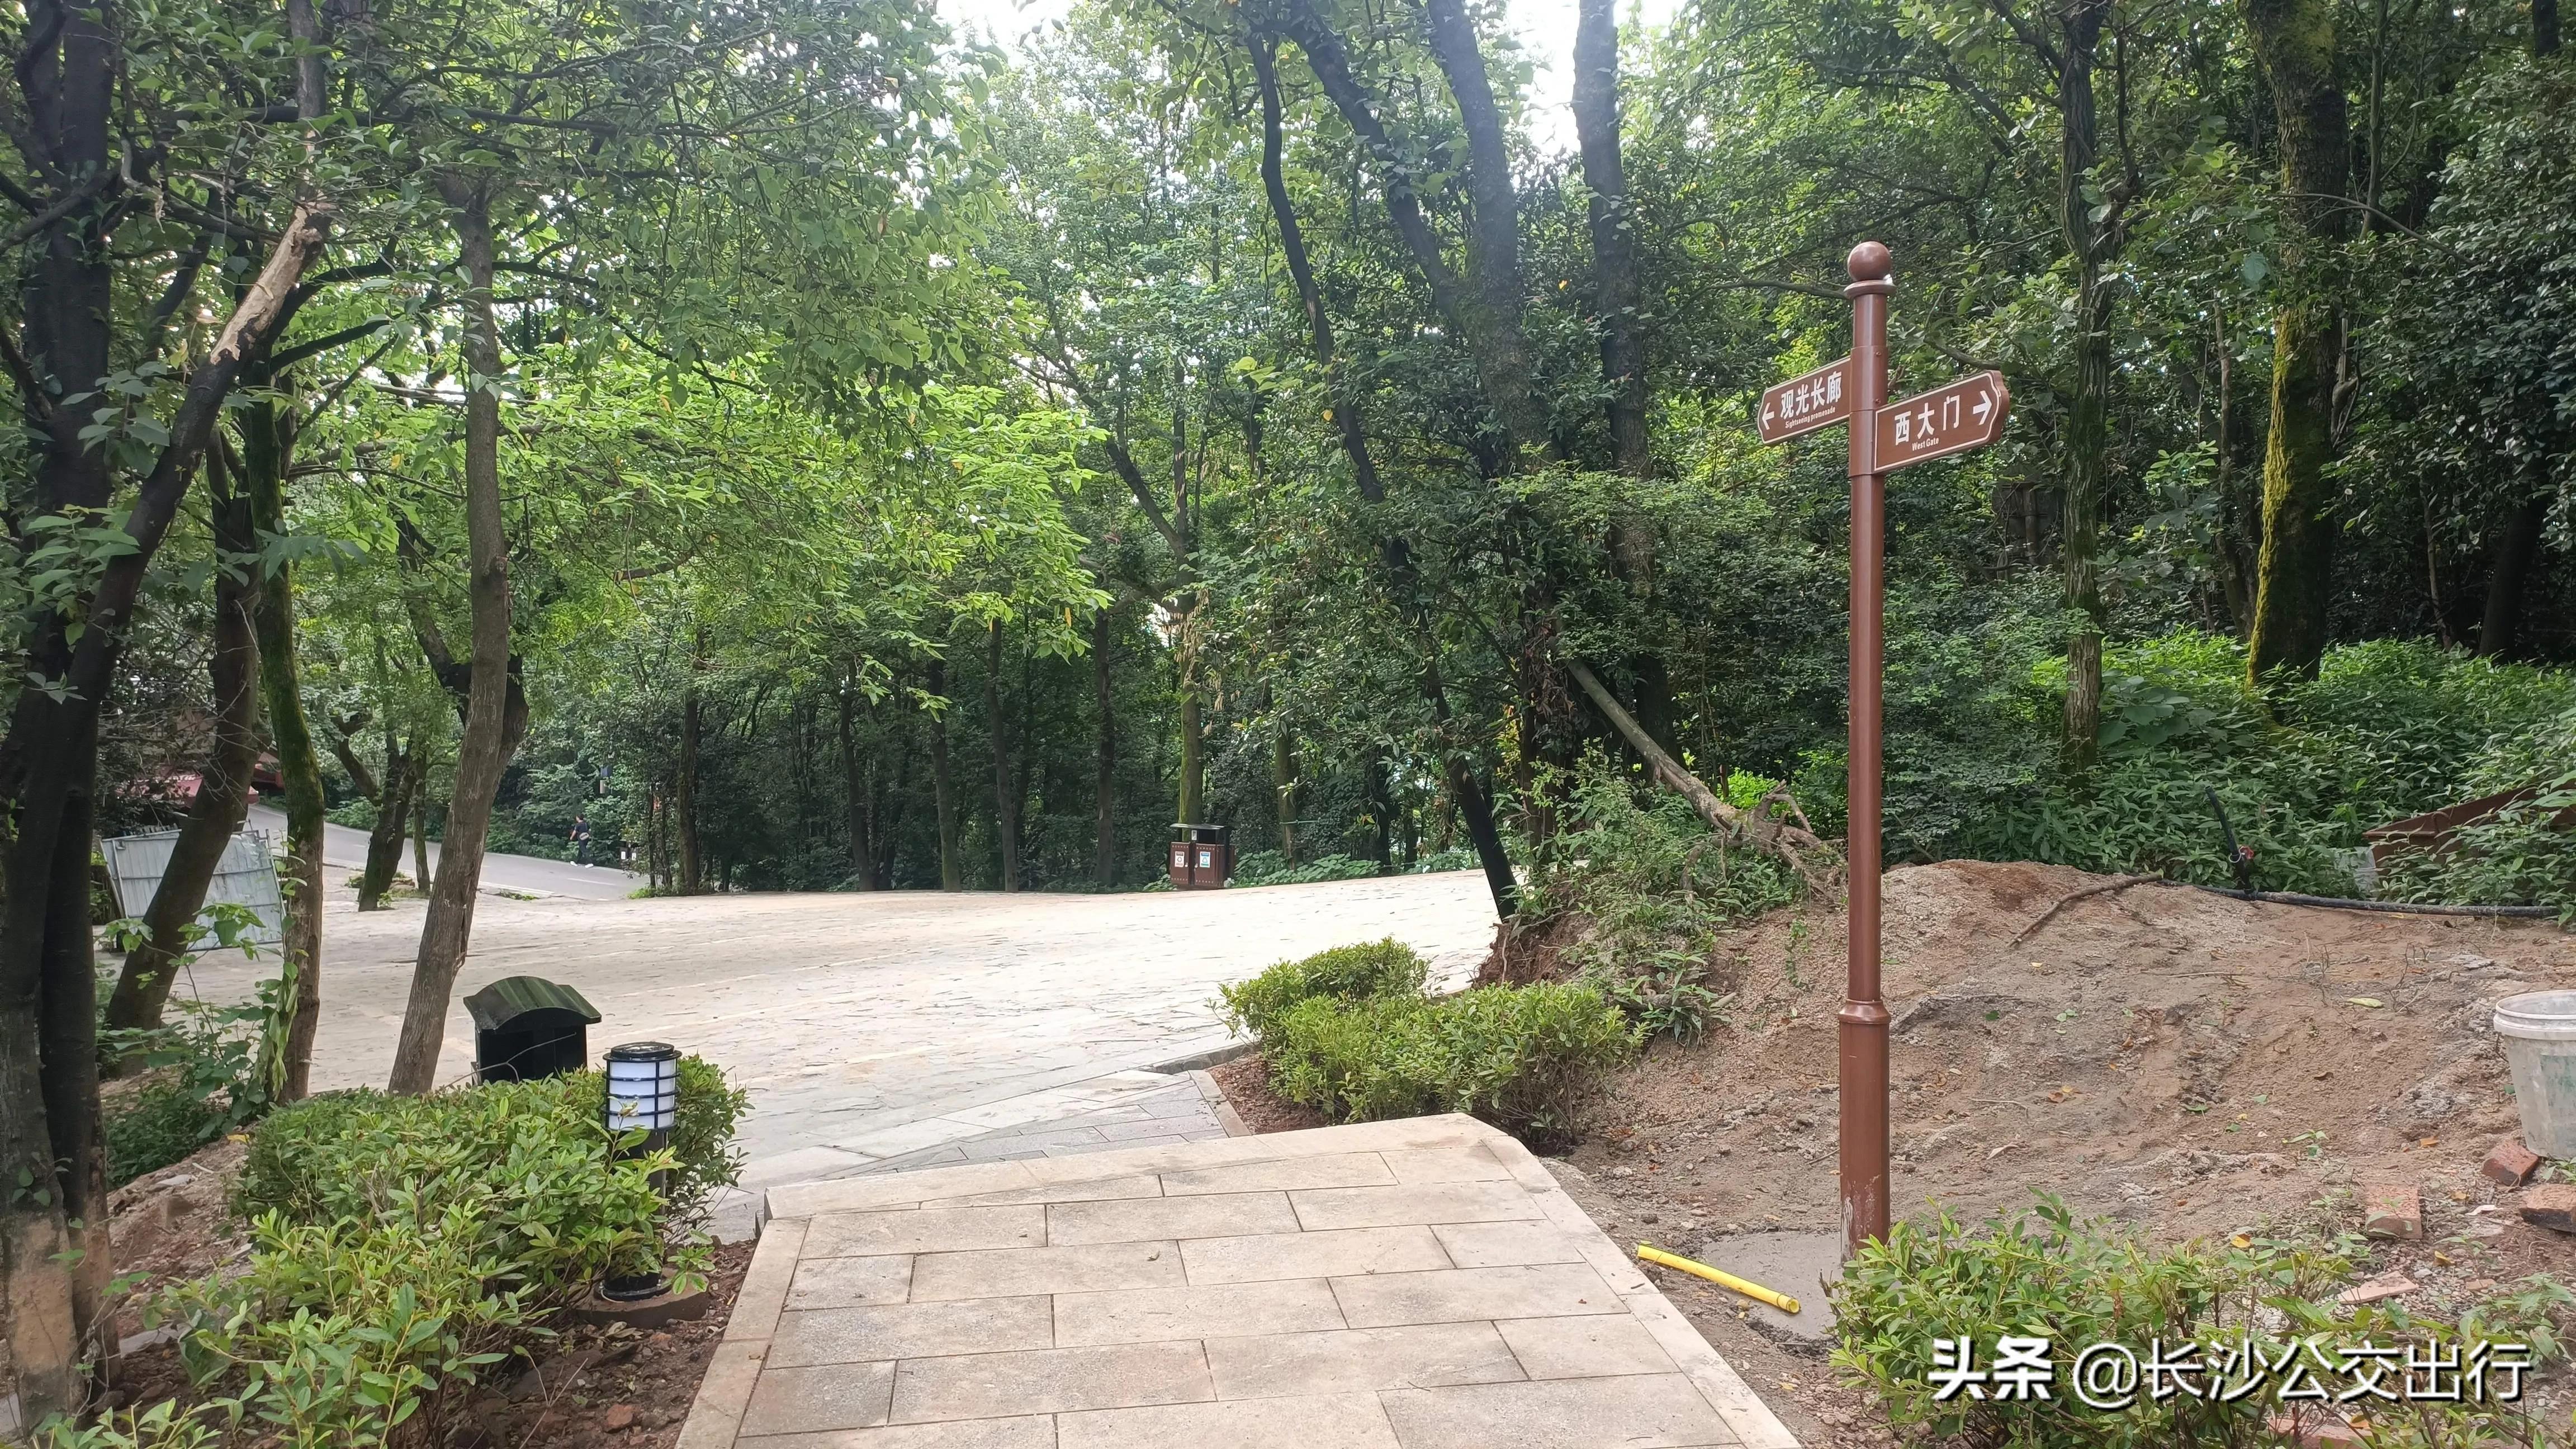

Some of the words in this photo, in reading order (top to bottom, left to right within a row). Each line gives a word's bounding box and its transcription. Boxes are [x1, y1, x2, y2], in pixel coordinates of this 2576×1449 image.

[1780, 371, 1842, 420] 观光长廊
[1785, 415, 1811, 429] Sightseeing
[1811, 405, 1836, 423] promenade
[1894, 395, 1960, 446] 西大门
[1912, 441, 1925, 451] West
[1926, 438, 1939, 447] Gate
